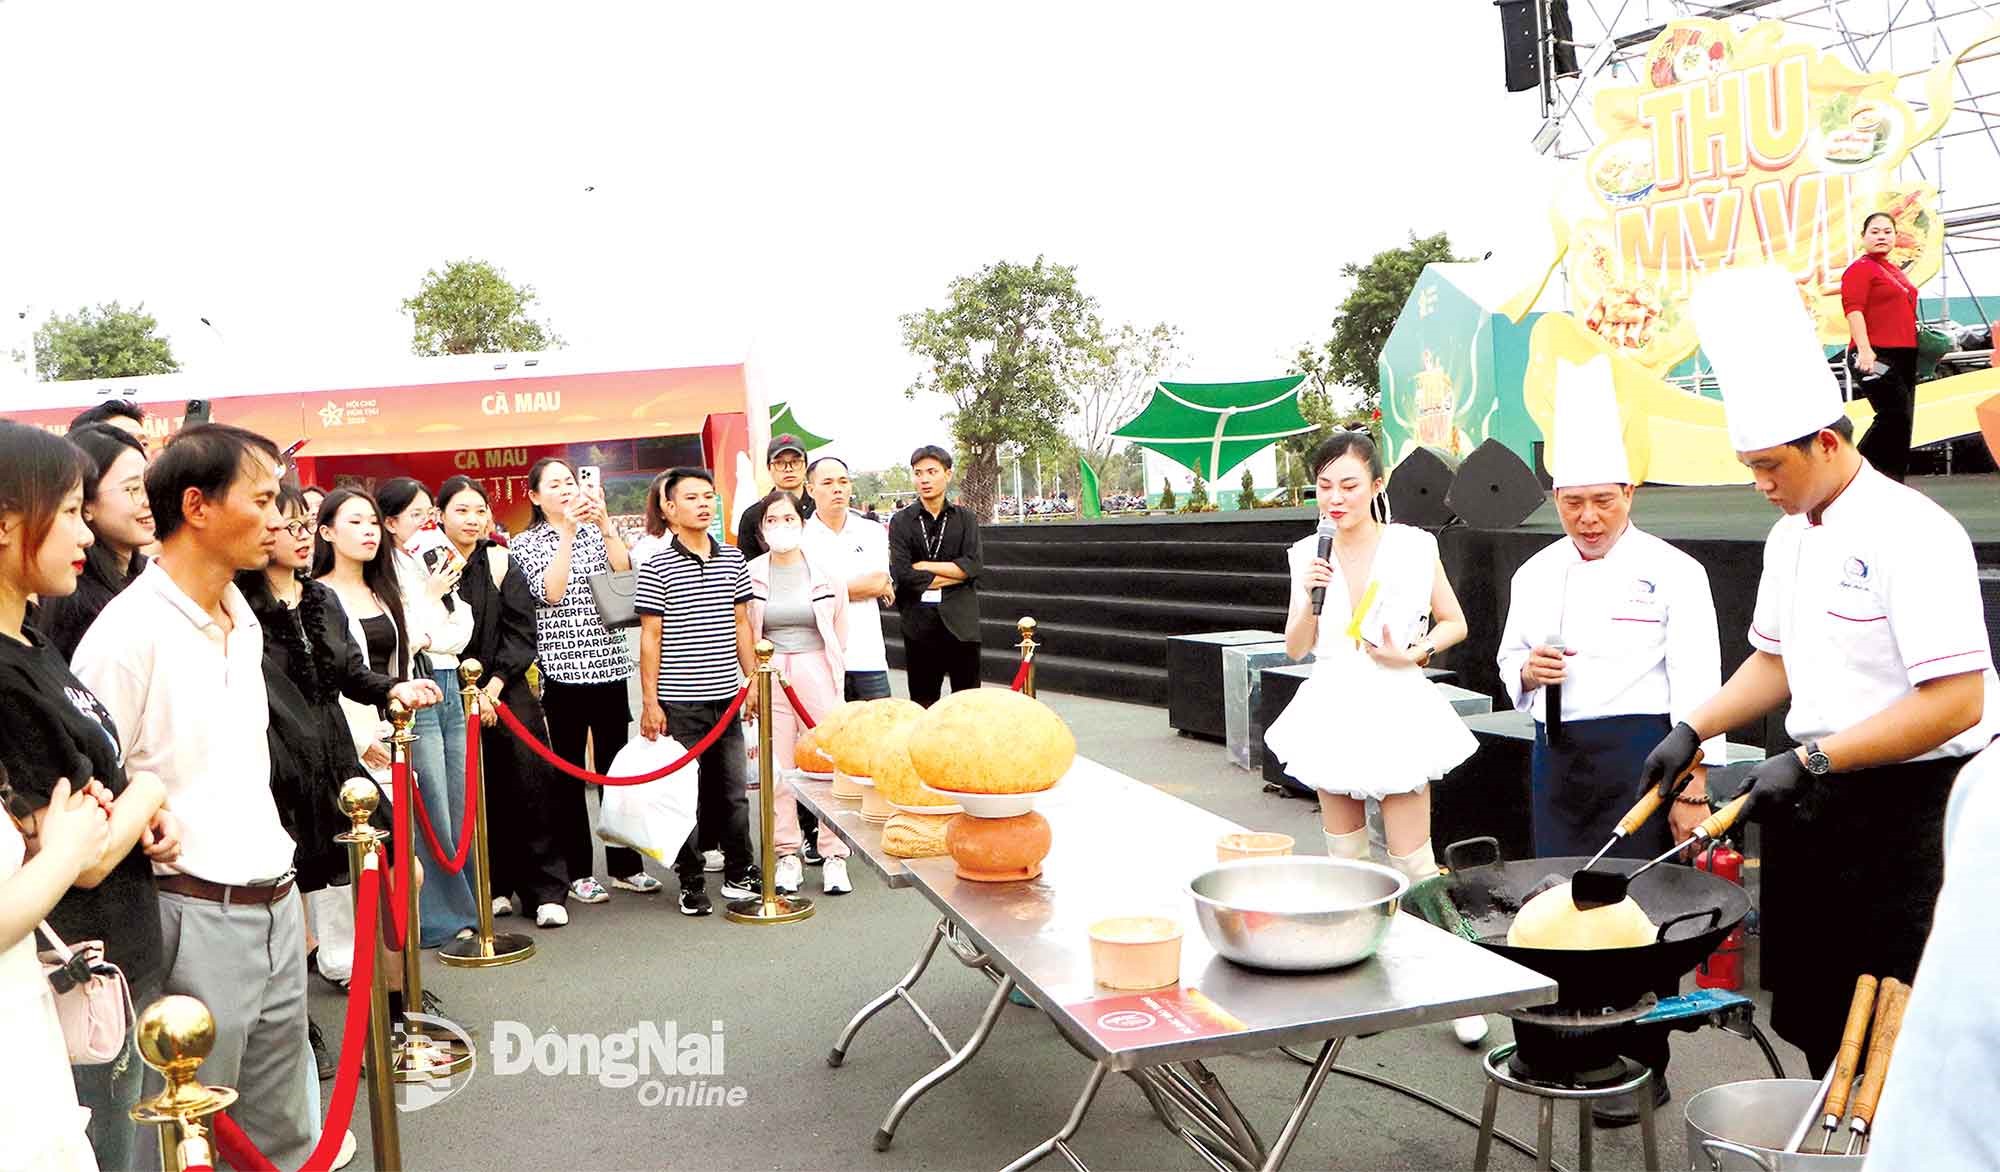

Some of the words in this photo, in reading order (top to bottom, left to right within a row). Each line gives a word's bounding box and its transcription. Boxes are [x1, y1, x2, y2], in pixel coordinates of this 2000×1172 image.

[481, 391, 509, 415] CÀ
[514, 391, 560, 413] MAU
[485, 448, 528, 468] MAU
[545, 619, 573, 630] KARL
[546, 629, 575, 641] PARIS
[578, 636, 609, 648] PARIS
[547, 648, 609, 661] LAGERFELD
[549, 661, 578, 672] KARL
